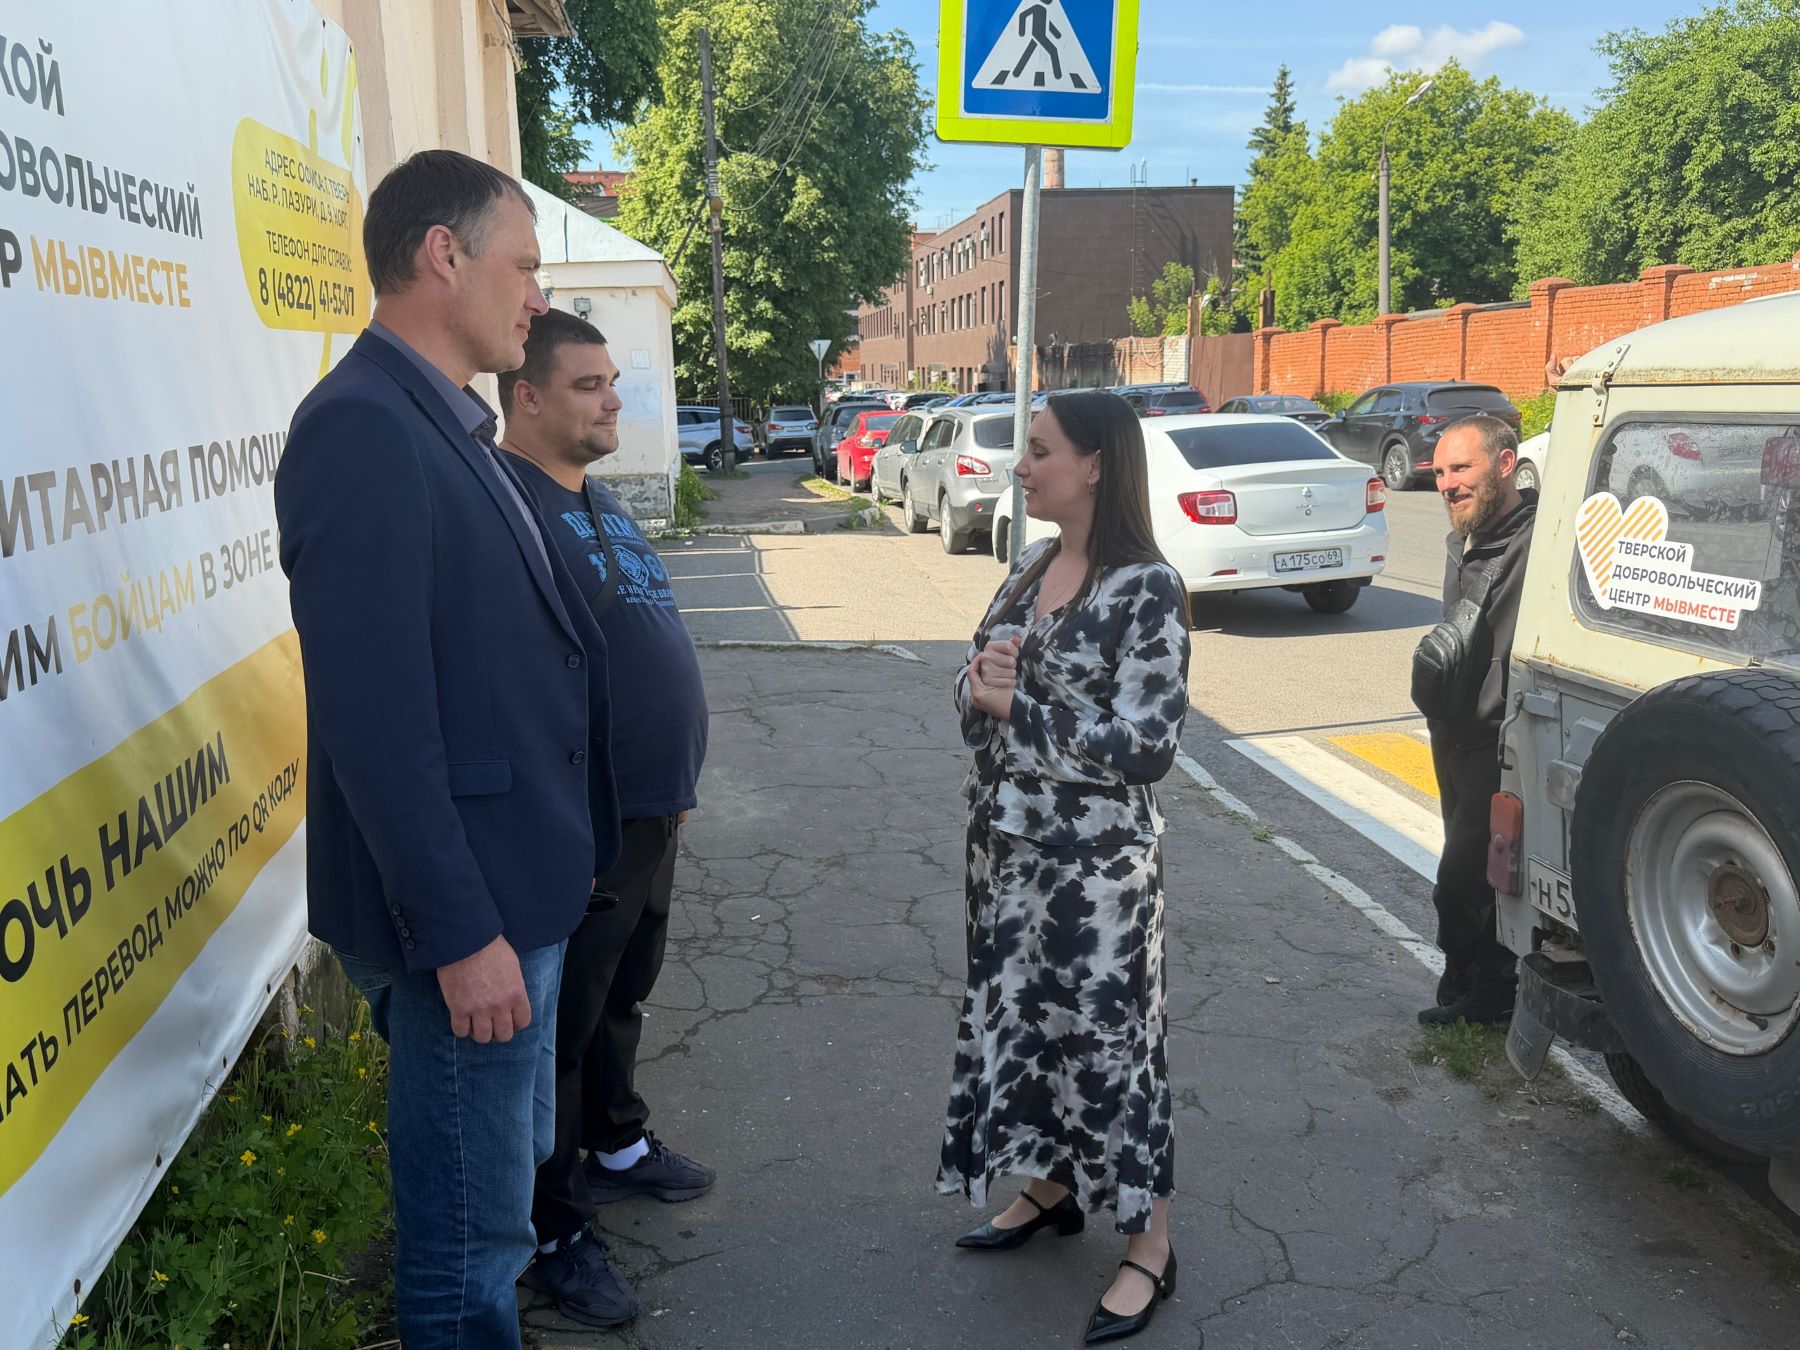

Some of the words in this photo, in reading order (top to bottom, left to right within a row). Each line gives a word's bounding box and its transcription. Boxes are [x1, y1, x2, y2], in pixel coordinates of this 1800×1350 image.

[264, 147, 296, 179] АДРЕС
[247, 173, 271, 203] НАБ.
[265, 230, 310, 261] ТЕЛЕФОН
[311, 242, 327, 267] ДЛЯ
[29, 234, 191, 308] МЫВМЕСТЕ
[258, 267, 270, 306] 8
[272, 268, 317, 321] (4822)
[319, 279, 355, 317] 41-53-07
[1618, 540, 1687, 563] ТВЕРСКОЙ
[67, 558, 197, 666] БОЙЦАМ
[199, 552, 217, 600] В
[219, 527, 275, 591] ЗОНЕ
[1611, 564, 1757, 601] ДОБРОВОЛЬЧЕСКИЙ
[1608, 587, 1651, 607] ЦЕНТР
[1653, 596, 1737, 624] МЫВМЕСТЕ
[98, 729, 231, 893] НАШИМ
[0, 1029, 60, 1124] АТЬ
[62, 906, 164, 1048] ПЕРЕВОД
[164, 837, 226, 930] МОЖНО
[227, 813, 251, 857] ПО
[251, 792, 271, 834] QR
[270, 757, 300, 813] КОДУ
